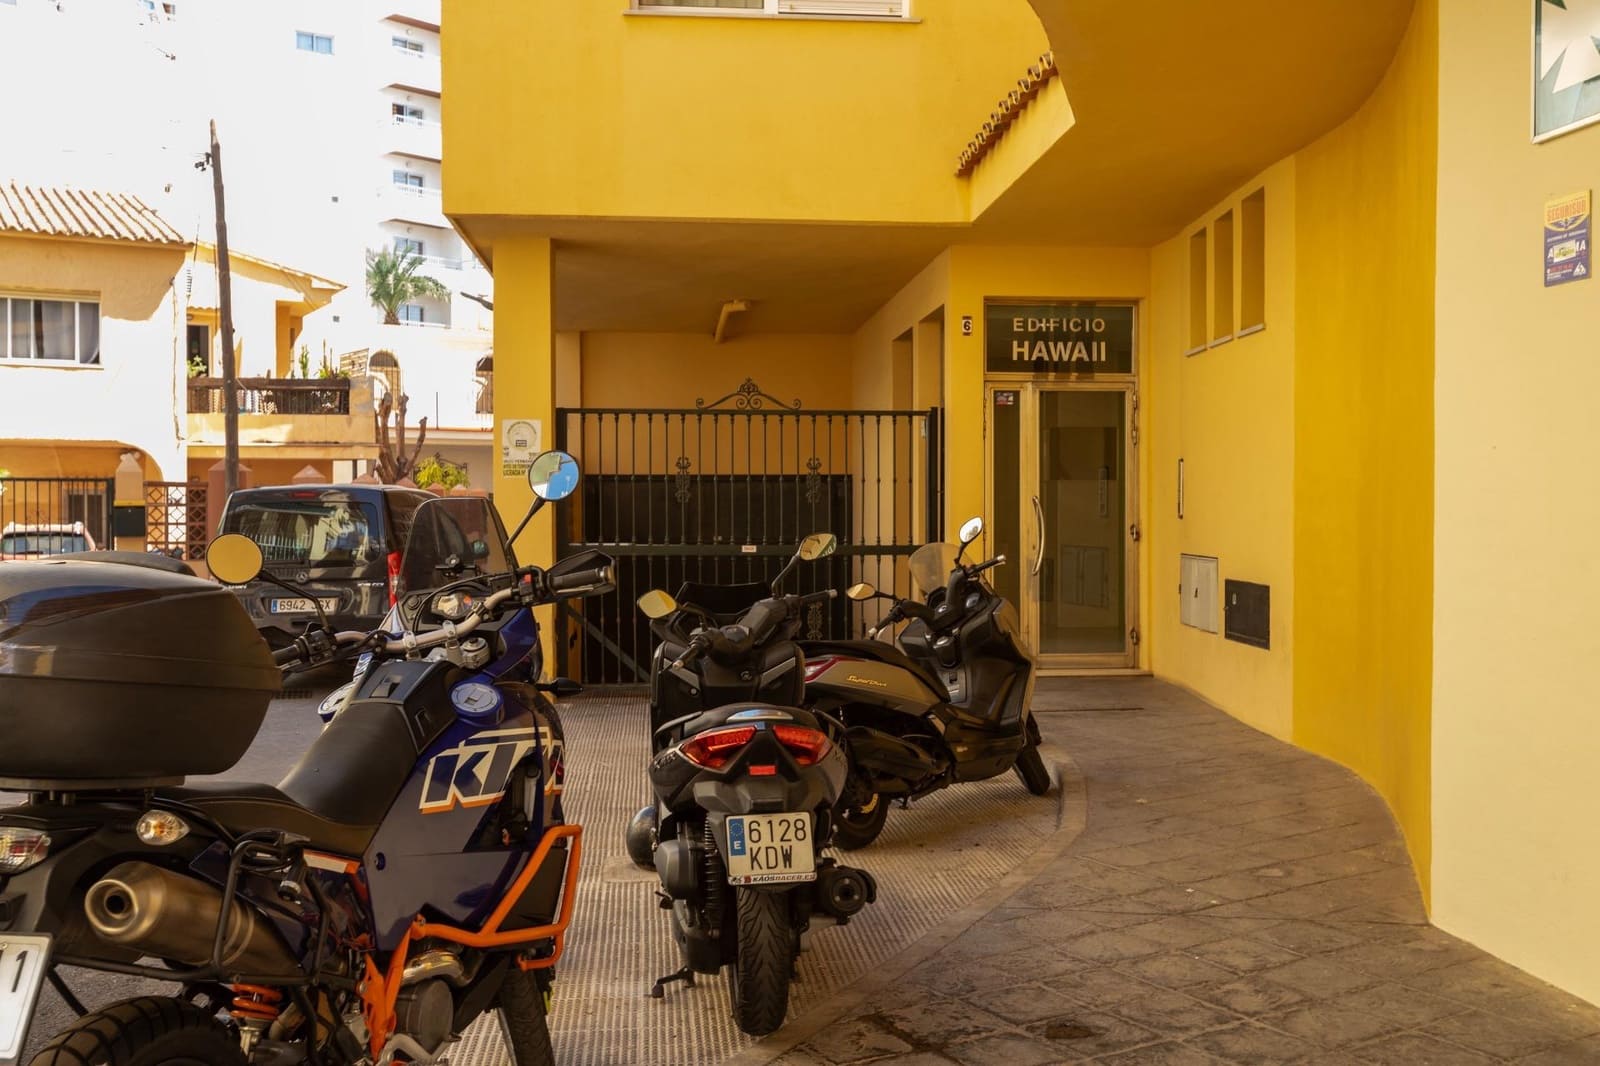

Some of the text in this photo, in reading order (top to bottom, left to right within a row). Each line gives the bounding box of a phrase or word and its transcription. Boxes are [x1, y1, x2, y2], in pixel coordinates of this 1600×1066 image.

[1547, 199, 1586, 222] SEGURISUR
[963, 320, 971, 331] 6
[1013, 317, 1105, 333] EDIFICIO
[1012, 340, 1106, 362] HAWAII
[279, 599, 331, 611] 6942 GX
[748, 819, 807, 843] 6128
[734, 840, 742, 850] E
[749, 845, 793, 871] KDW
